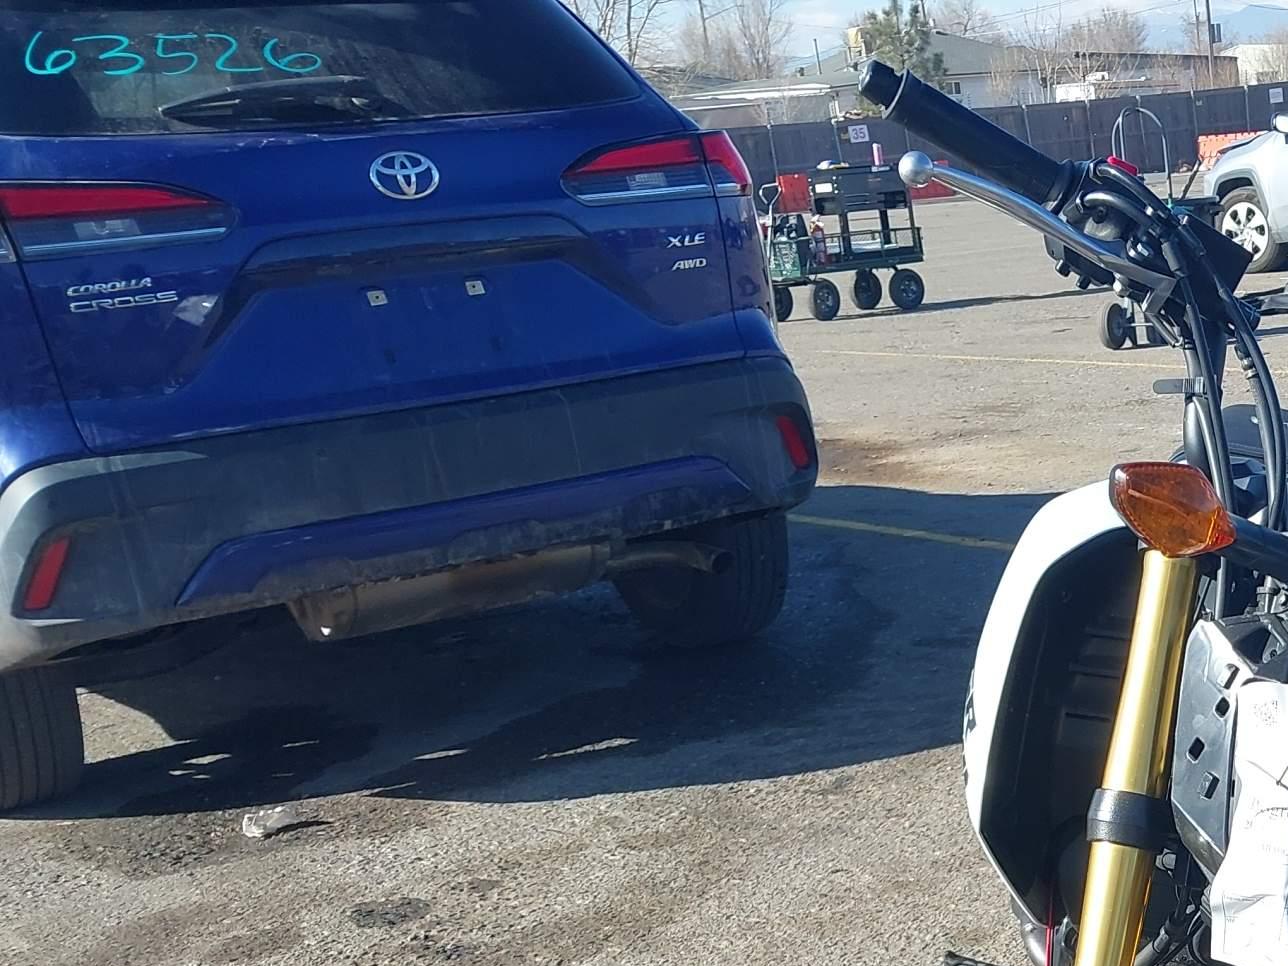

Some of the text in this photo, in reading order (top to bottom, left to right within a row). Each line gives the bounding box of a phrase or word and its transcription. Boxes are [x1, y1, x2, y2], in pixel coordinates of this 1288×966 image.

[25, 31, 322, 75] 63526
[851, 127, 866, 140] 35
[666, 231, 706, 249] XLE
[671, 257, 707, 271] AWD
[66, 277, 153, 297] COROLLA
[69, 291, 179, 313] CROSS
